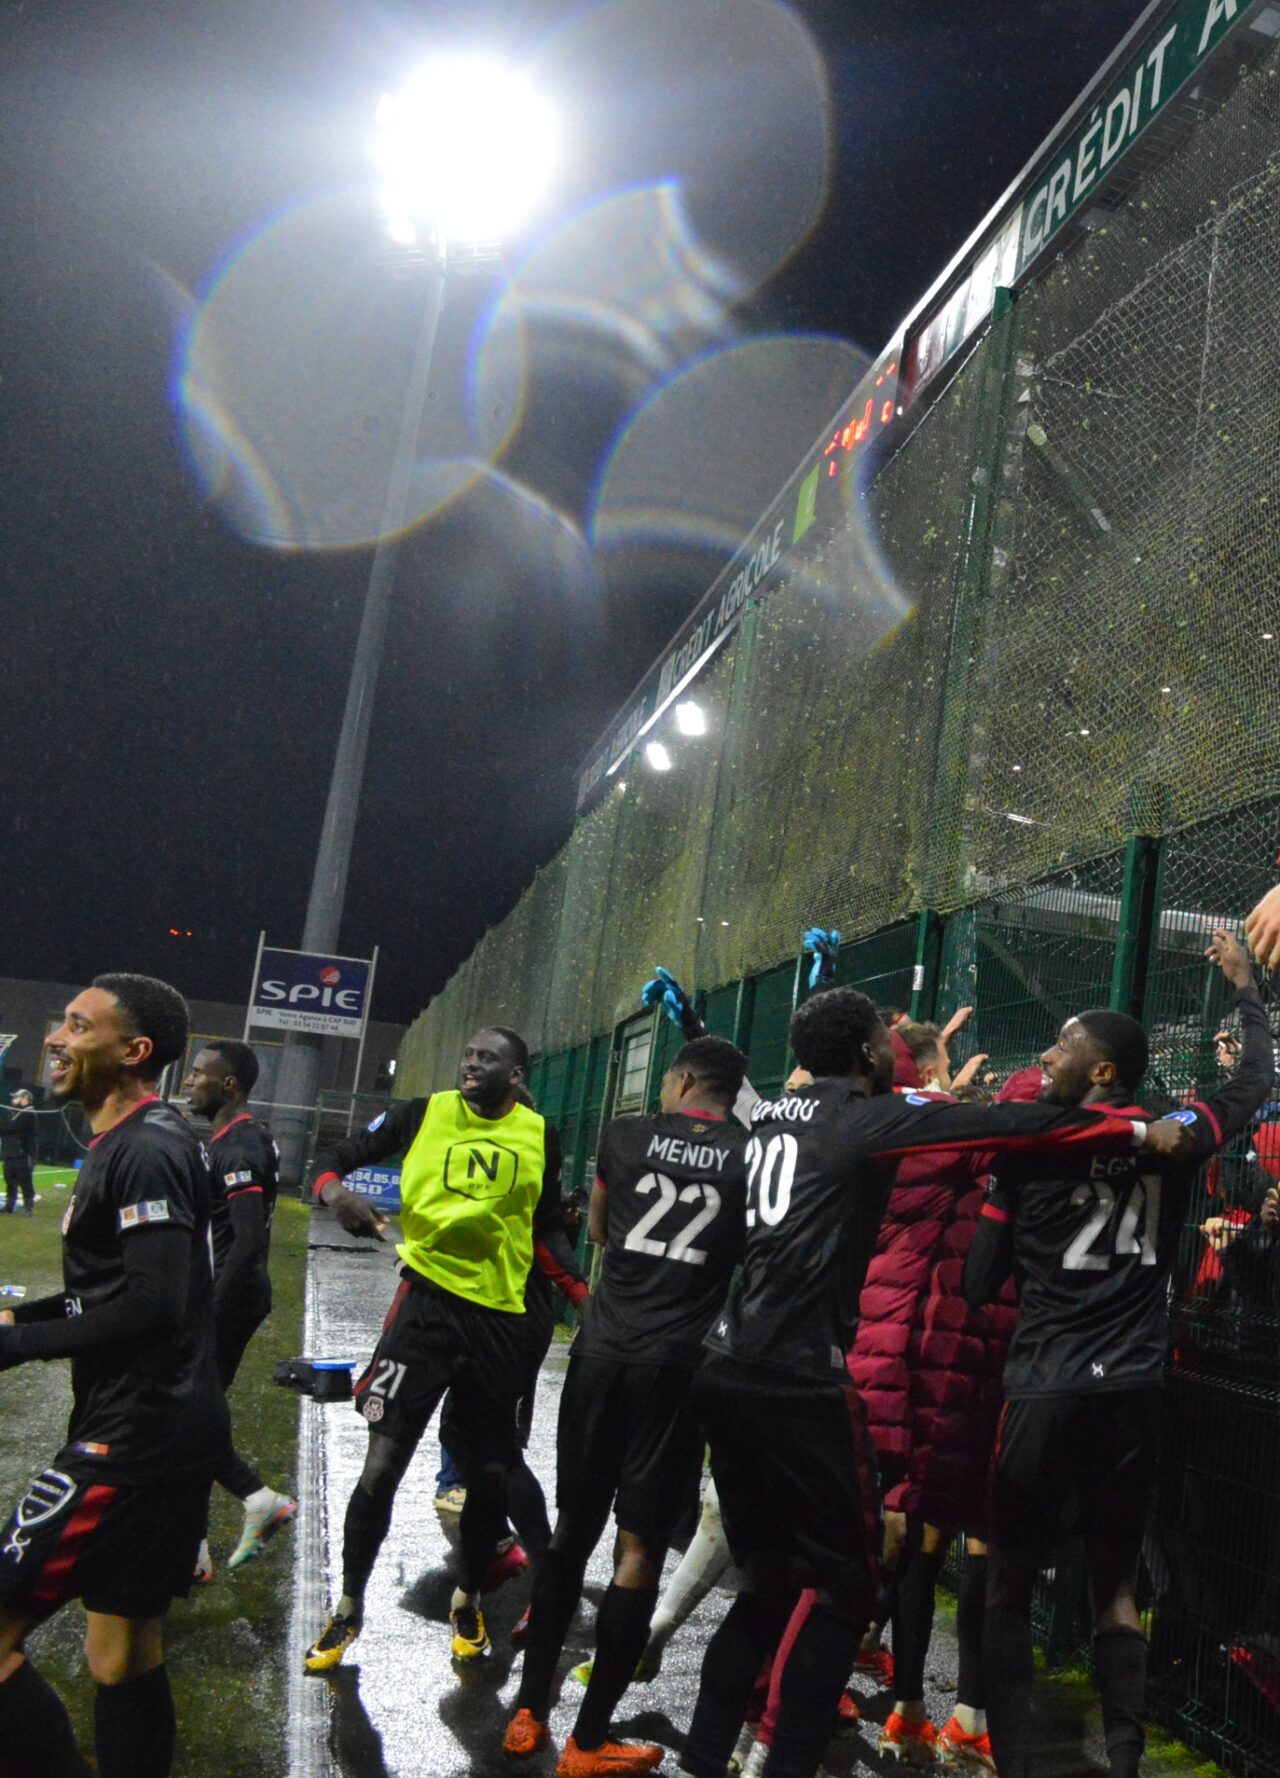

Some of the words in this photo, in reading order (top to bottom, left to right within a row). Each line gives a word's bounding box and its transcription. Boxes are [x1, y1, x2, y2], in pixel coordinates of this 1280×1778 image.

[1021, 23, 1177, 262] CRÉDIT
[260, 981, 361, 1010] SPIE
[467, 1149, 500, 1182] N
[647, 1134, 730, 1171] MENDY
[624, 1172, 722, 1265] 22
[1062, 1174, 1162, 1270] 24
[370, 1359, 408, 1400] 21
